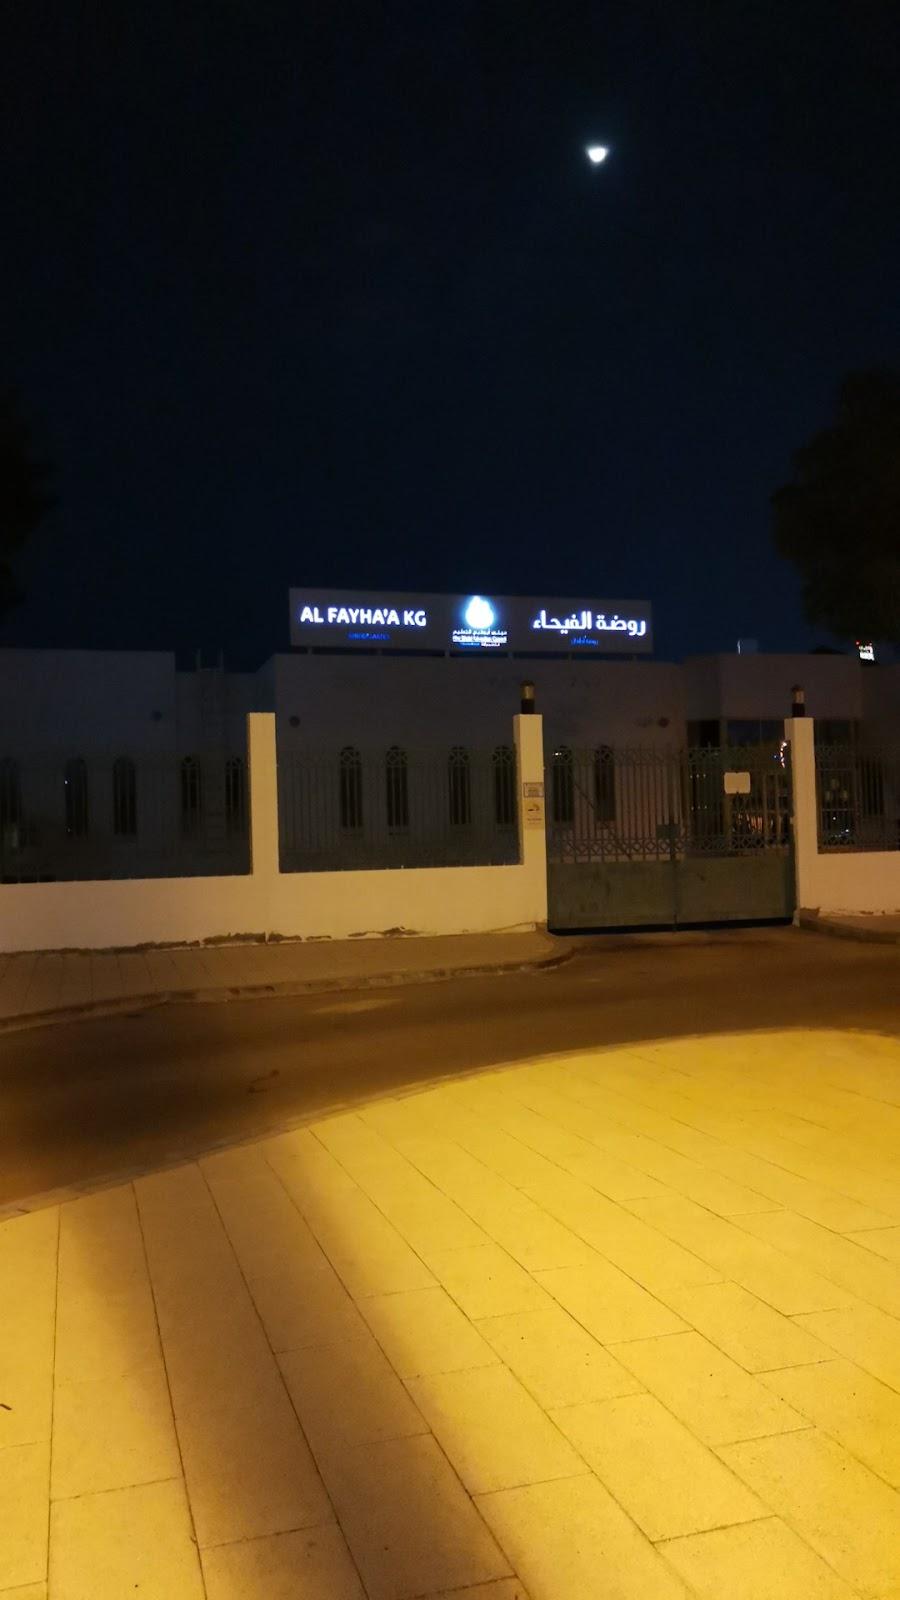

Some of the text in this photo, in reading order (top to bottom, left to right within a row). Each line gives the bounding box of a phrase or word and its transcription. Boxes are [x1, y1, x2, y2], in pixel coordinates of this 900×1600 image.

[299, 606, 427, 627] AL FAYHA'A KG
[532, 609, 647, 637] روضة الفيحاء
